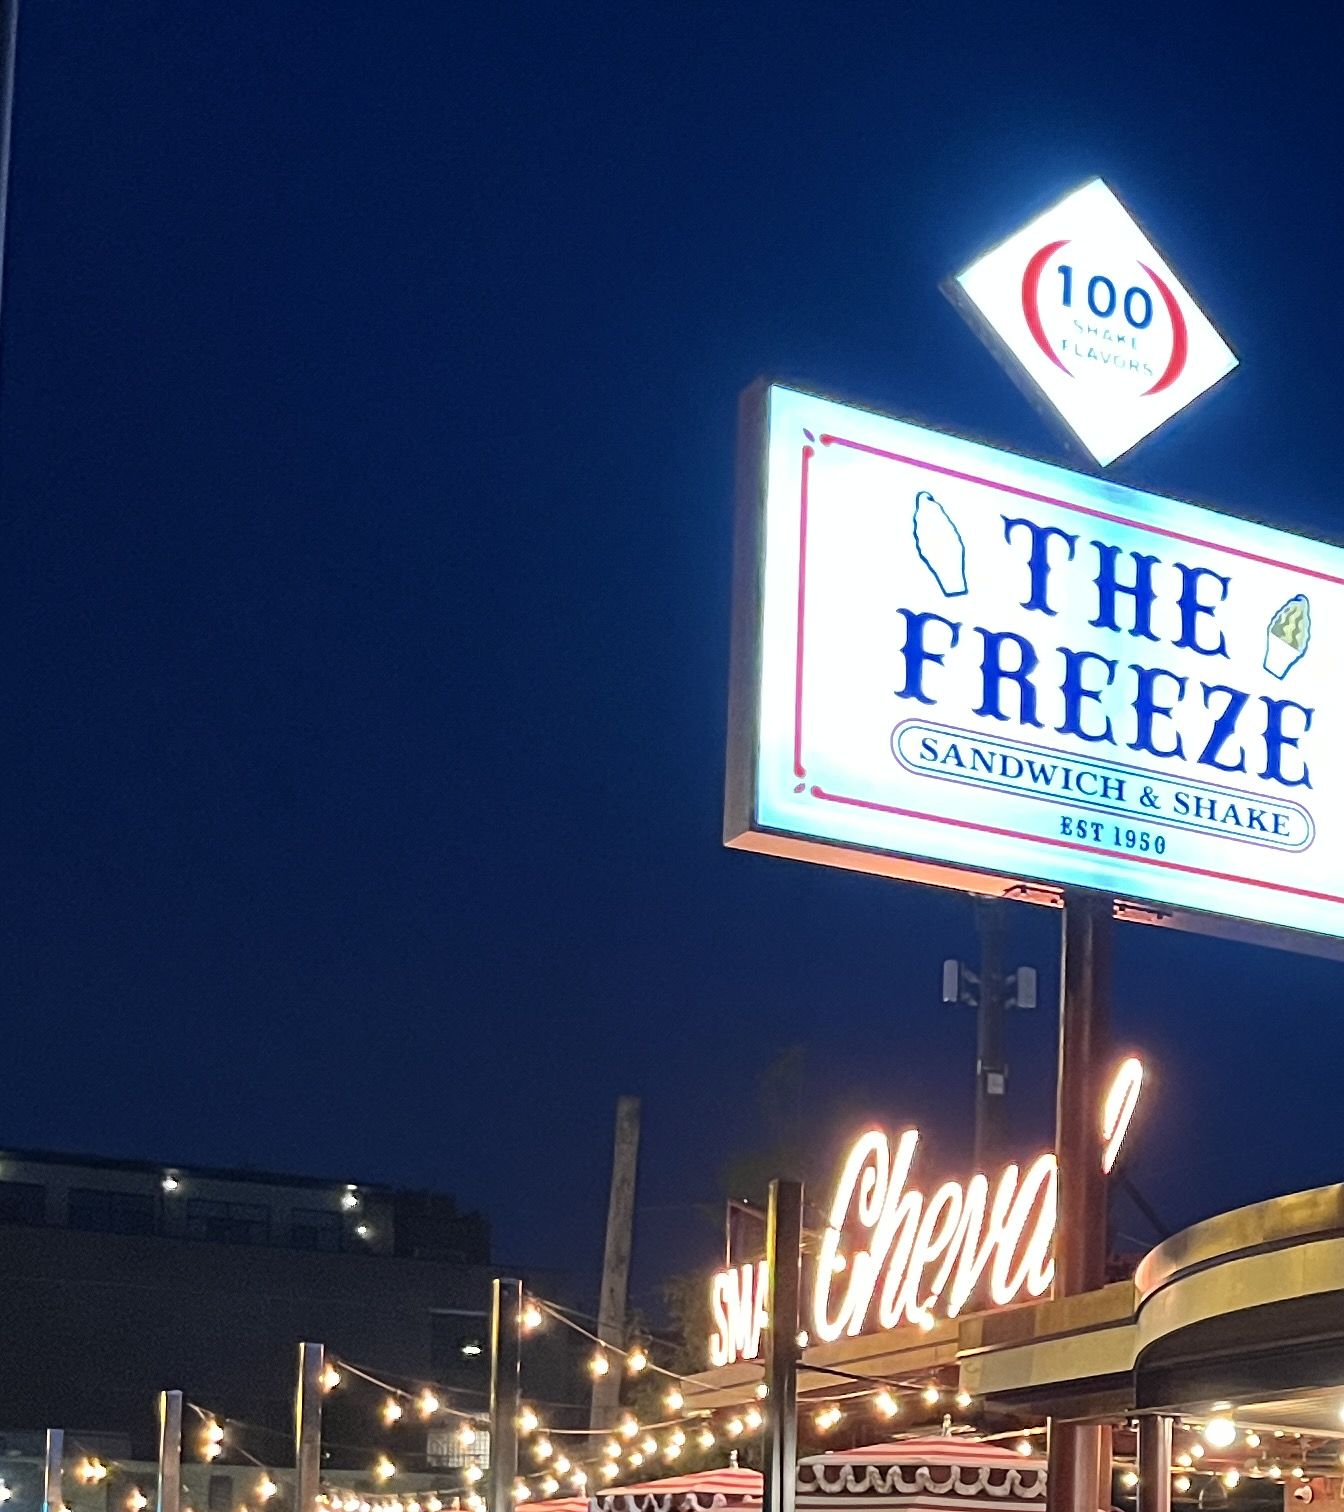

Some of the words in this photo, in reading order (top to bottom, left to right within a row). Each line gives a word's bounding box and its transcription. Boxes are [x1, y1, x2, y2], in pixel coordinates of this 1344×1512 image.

[1057, 264, 1154, 330] 100
[1061, 339, 1154, 377] FLAVORS
[1073, 319, 1137, 350] SHAKE
[1000, 514, 1232, 660] THE
[894, 607, 1316, 790] FREEZE
[918, 737, 1127, 802] SANDWICH
[1140, 785, 1162, 810] &
[1172, 791, 1292, 838] SHAKE
[1060, 815, 1104, 842] EST
[1114, 826, 1167, 855] 1950
